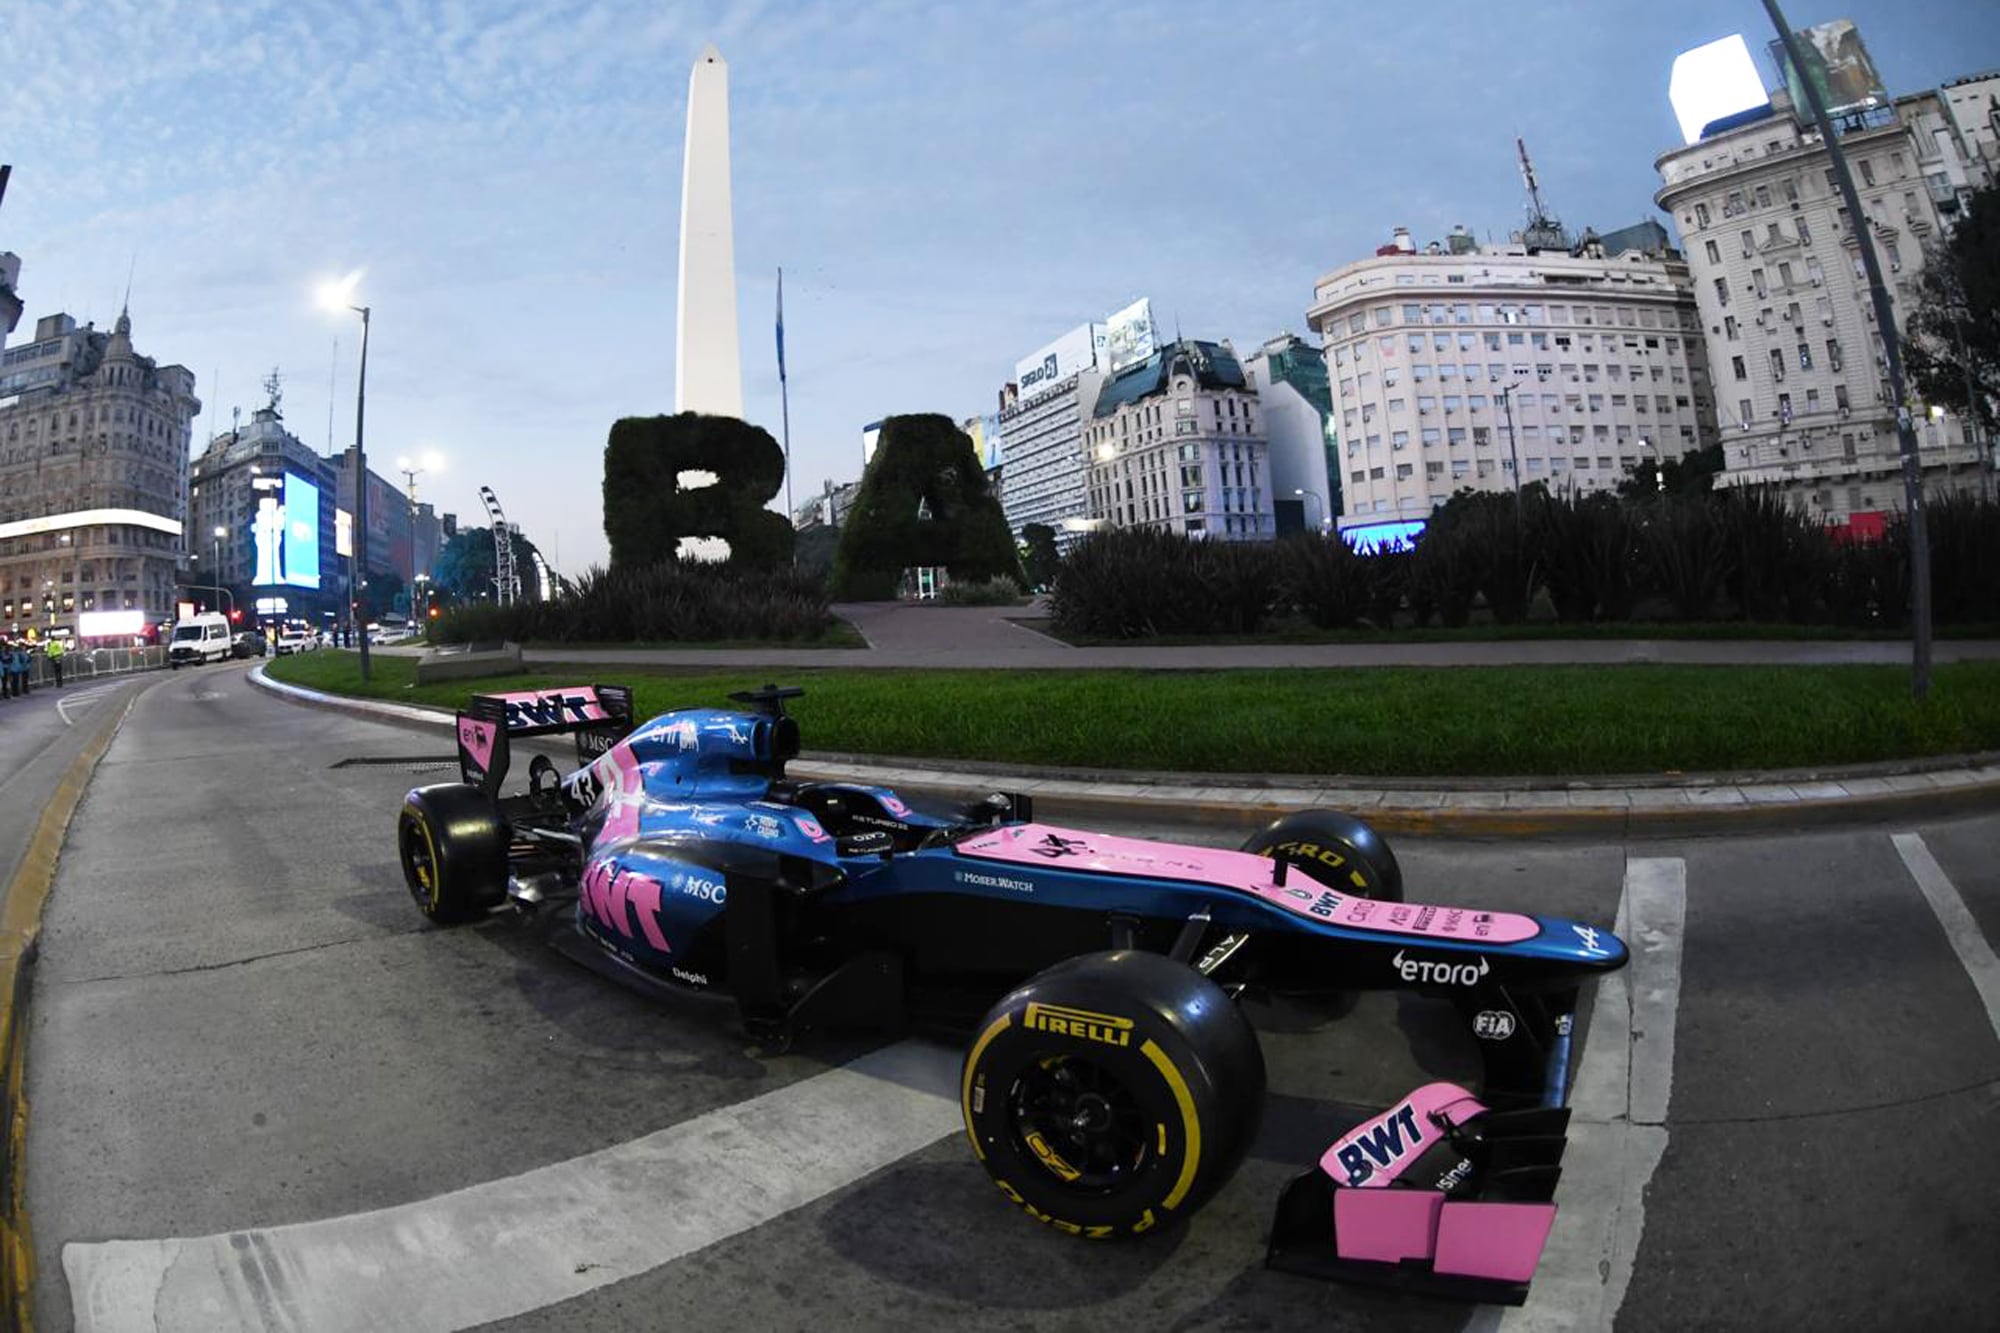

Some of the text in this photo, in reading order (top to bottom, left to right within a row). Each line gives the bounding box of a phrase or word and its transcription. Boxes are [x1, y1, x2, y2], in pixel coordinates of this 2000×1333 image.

[588, 734, 614, 751] MSC
[571, 769, 596, 807] 43
[683, 876, 728, 904] MSC
[1309, 891, 1343, 917] BWT
[672, 966, 708, 985] Delphi
[1024, 1001, 1135, 1047] PIRELLI
[1475, 1016, 1510, 1035] FIA
[1337, 1103, 1422, 1188] BWT
